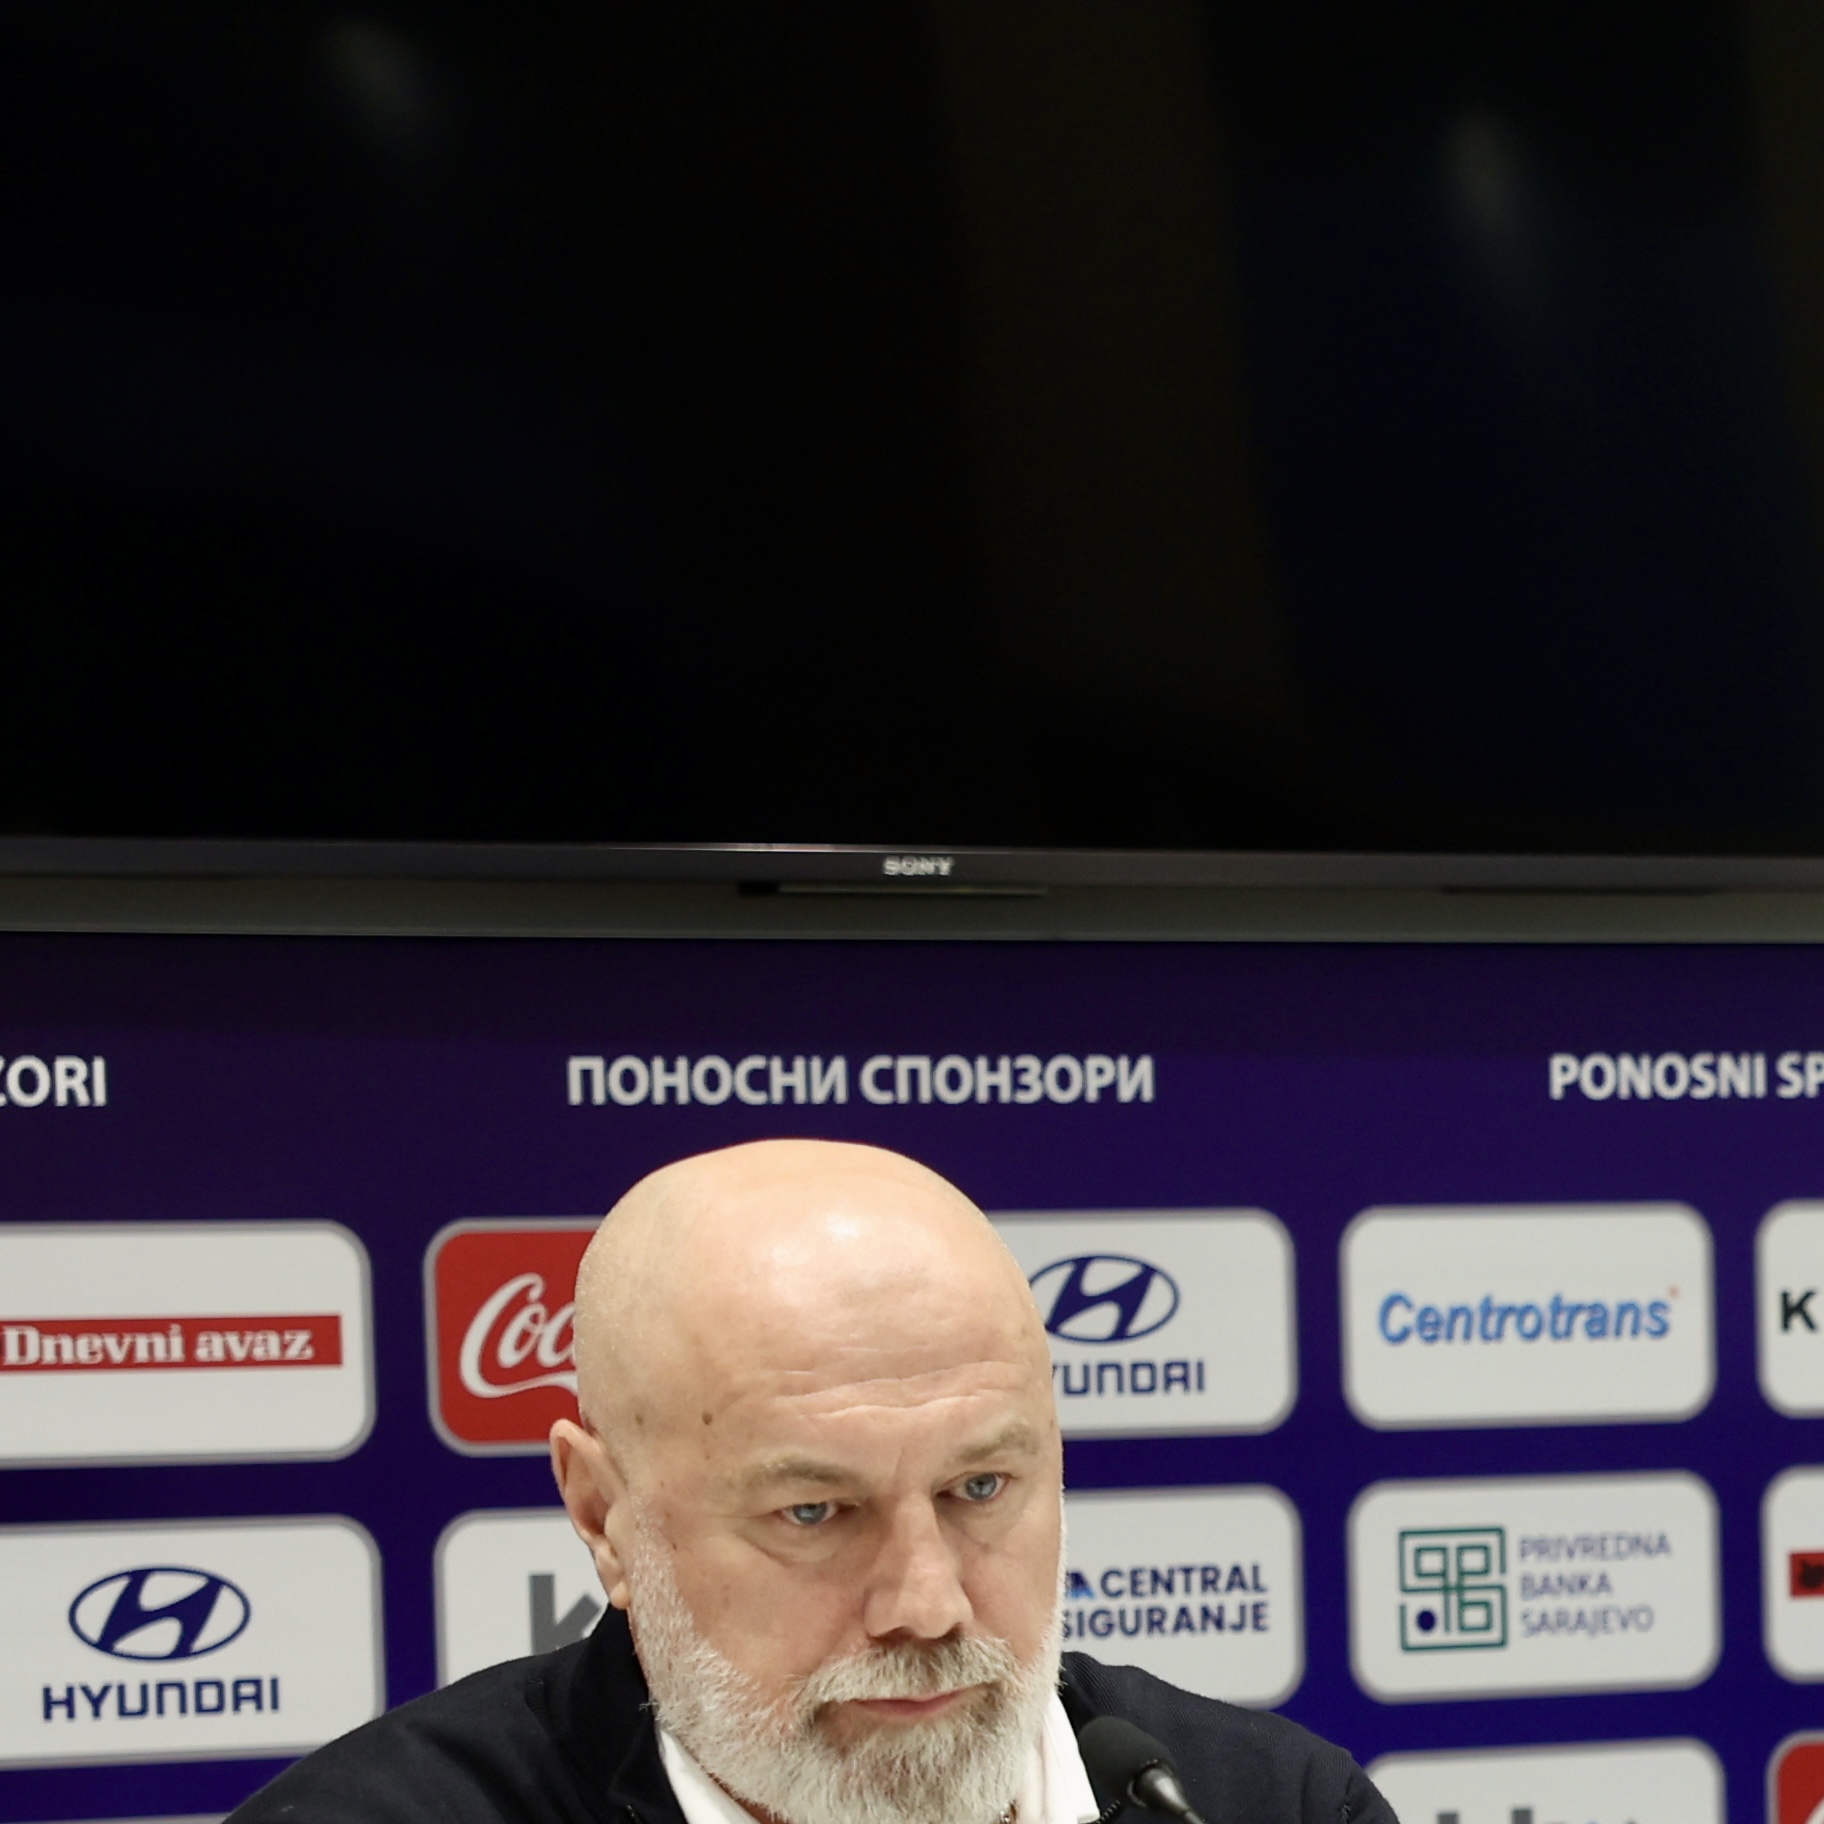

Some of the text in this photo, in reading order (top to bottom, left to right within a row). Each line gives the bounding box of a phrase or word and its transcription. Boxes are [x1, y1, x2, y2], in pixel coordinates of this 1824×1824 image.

[883, 857, 952, 876] SONY
[0, 1055, 107, 1107] ORI
[567, 1055, 1155, 1107] ПОНОСНИ СПОНЗОРИ
[1549, 1053, 1765, 1100] PONOSNI
[1380, 1293, 1671, 1345] Centrotrans
[2, 1323, 315, 1366] Dnevni avaz
[1053, 1361, 1205, 1396] UNDAI
[1519, 1532, 1671, 1561] PRIVREDNA
[1101, 1565, 1267, 1598] CENTRAL
[1520, 1573, 1613, 1600] BANKA
[1520, 1605, 1653, 1638] SARAJEVO
[43, 1676, 280, 1722] HYUNDAI
